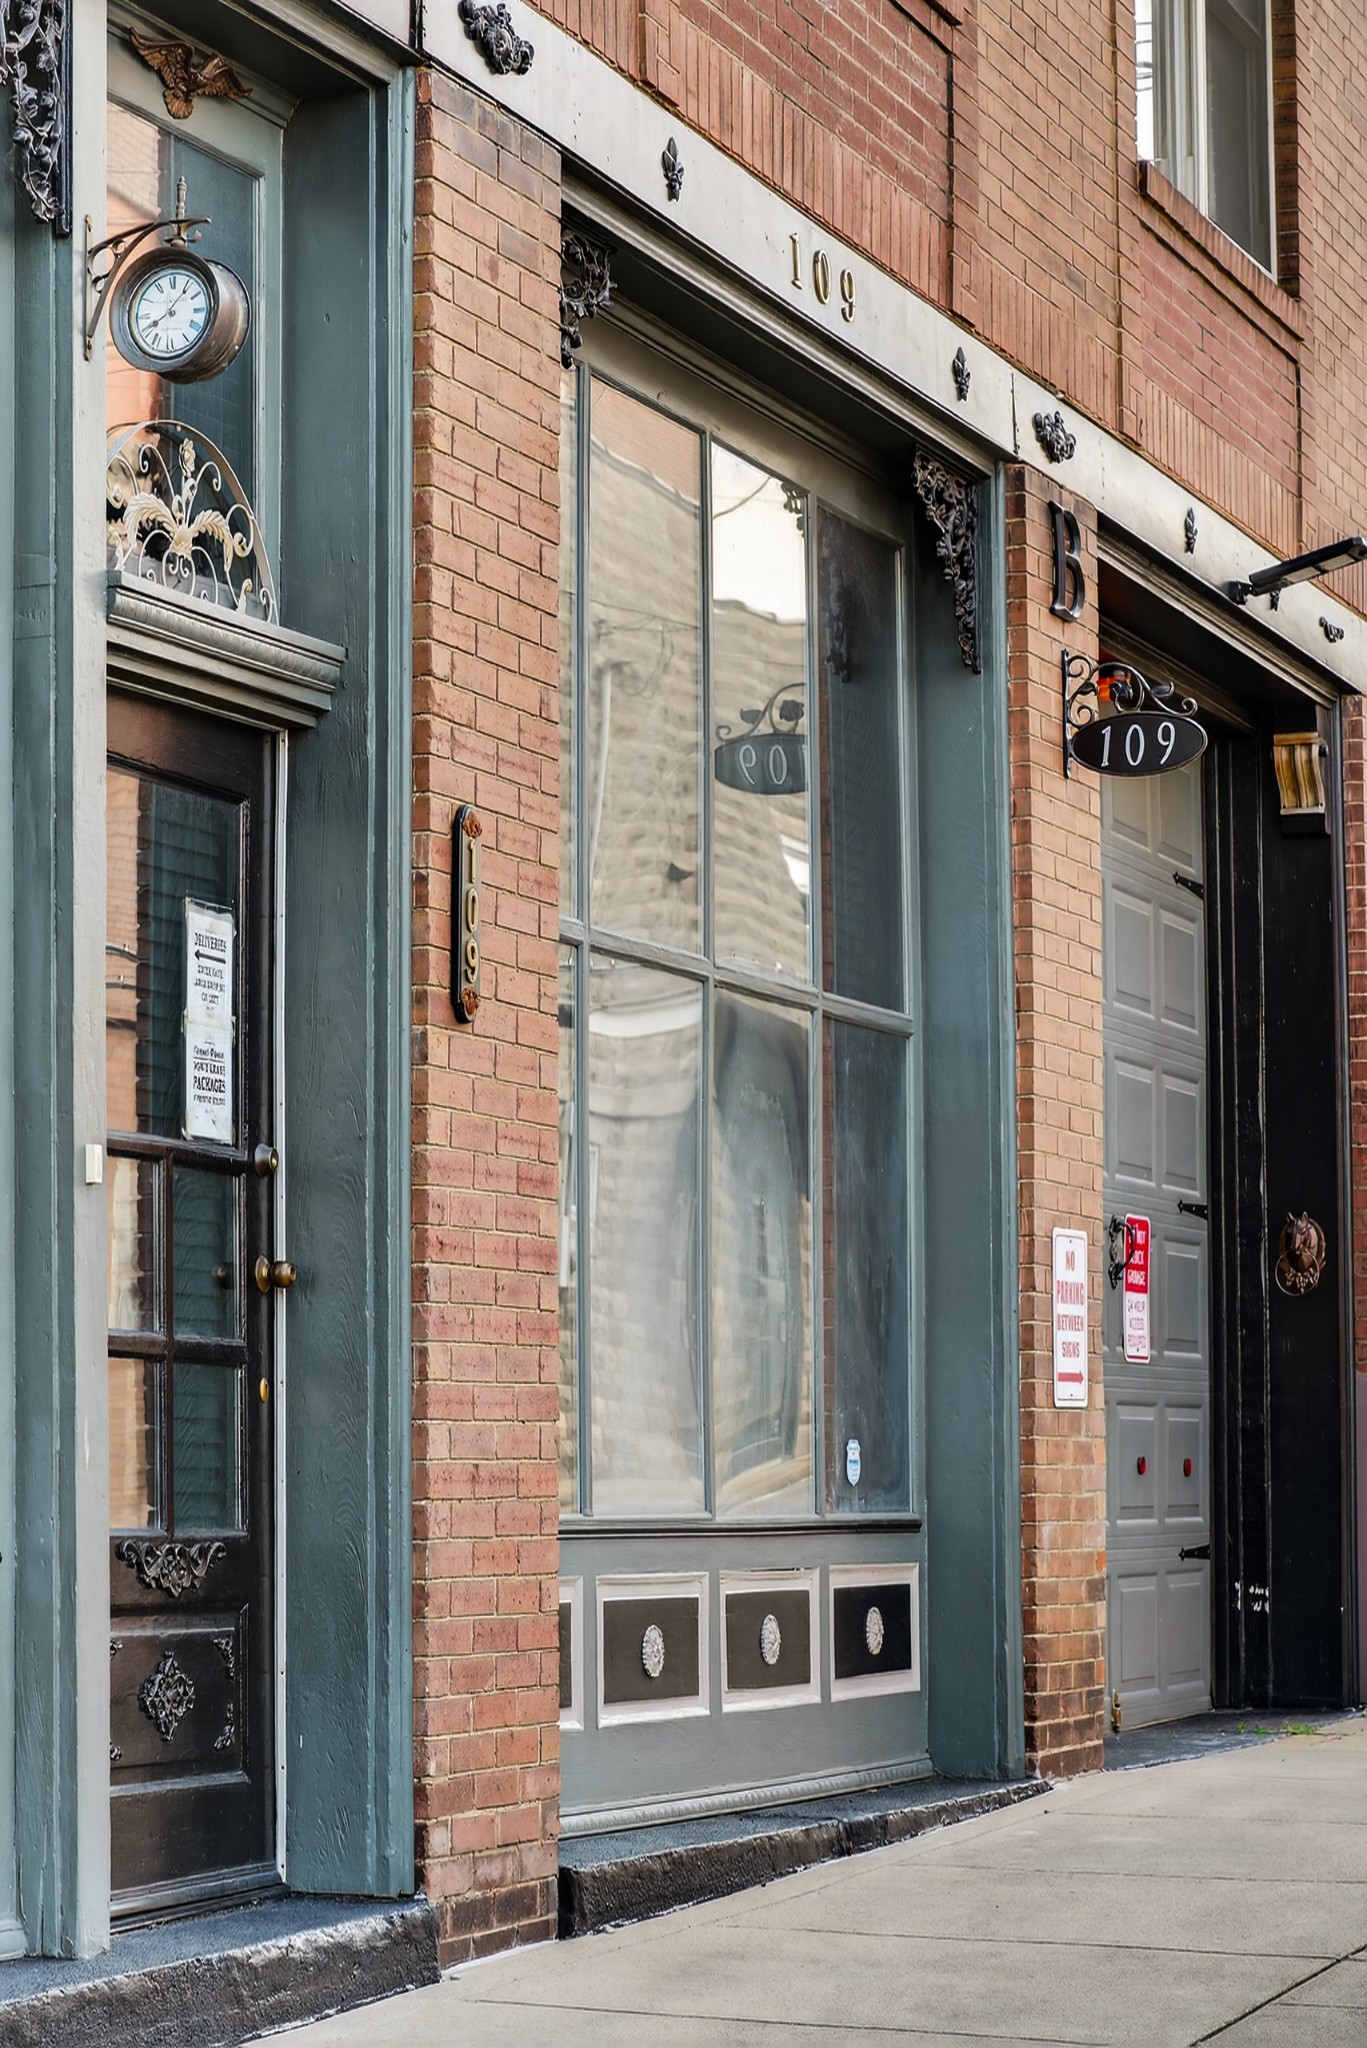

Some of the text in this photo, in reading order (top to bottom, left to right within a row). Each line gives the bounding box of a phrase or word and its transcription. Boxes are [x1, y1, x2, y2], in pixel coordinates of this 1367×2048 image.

[789, 232, 856, 323] 109
[1048, 500, 1085, 622] B
[1101, 721, 1176, 767] 109
[465, 838, 479, 984] 109
[193, 1075, 226, 1094] PACKAGES
[1065, 1250, 1076, 1271] NO
[1056, 1280, 1084, 1306] PARKING
[1057, 1314, 1084, 1332] BETWEEN
[1062, 1340, 1080, 1359] SIGNS
